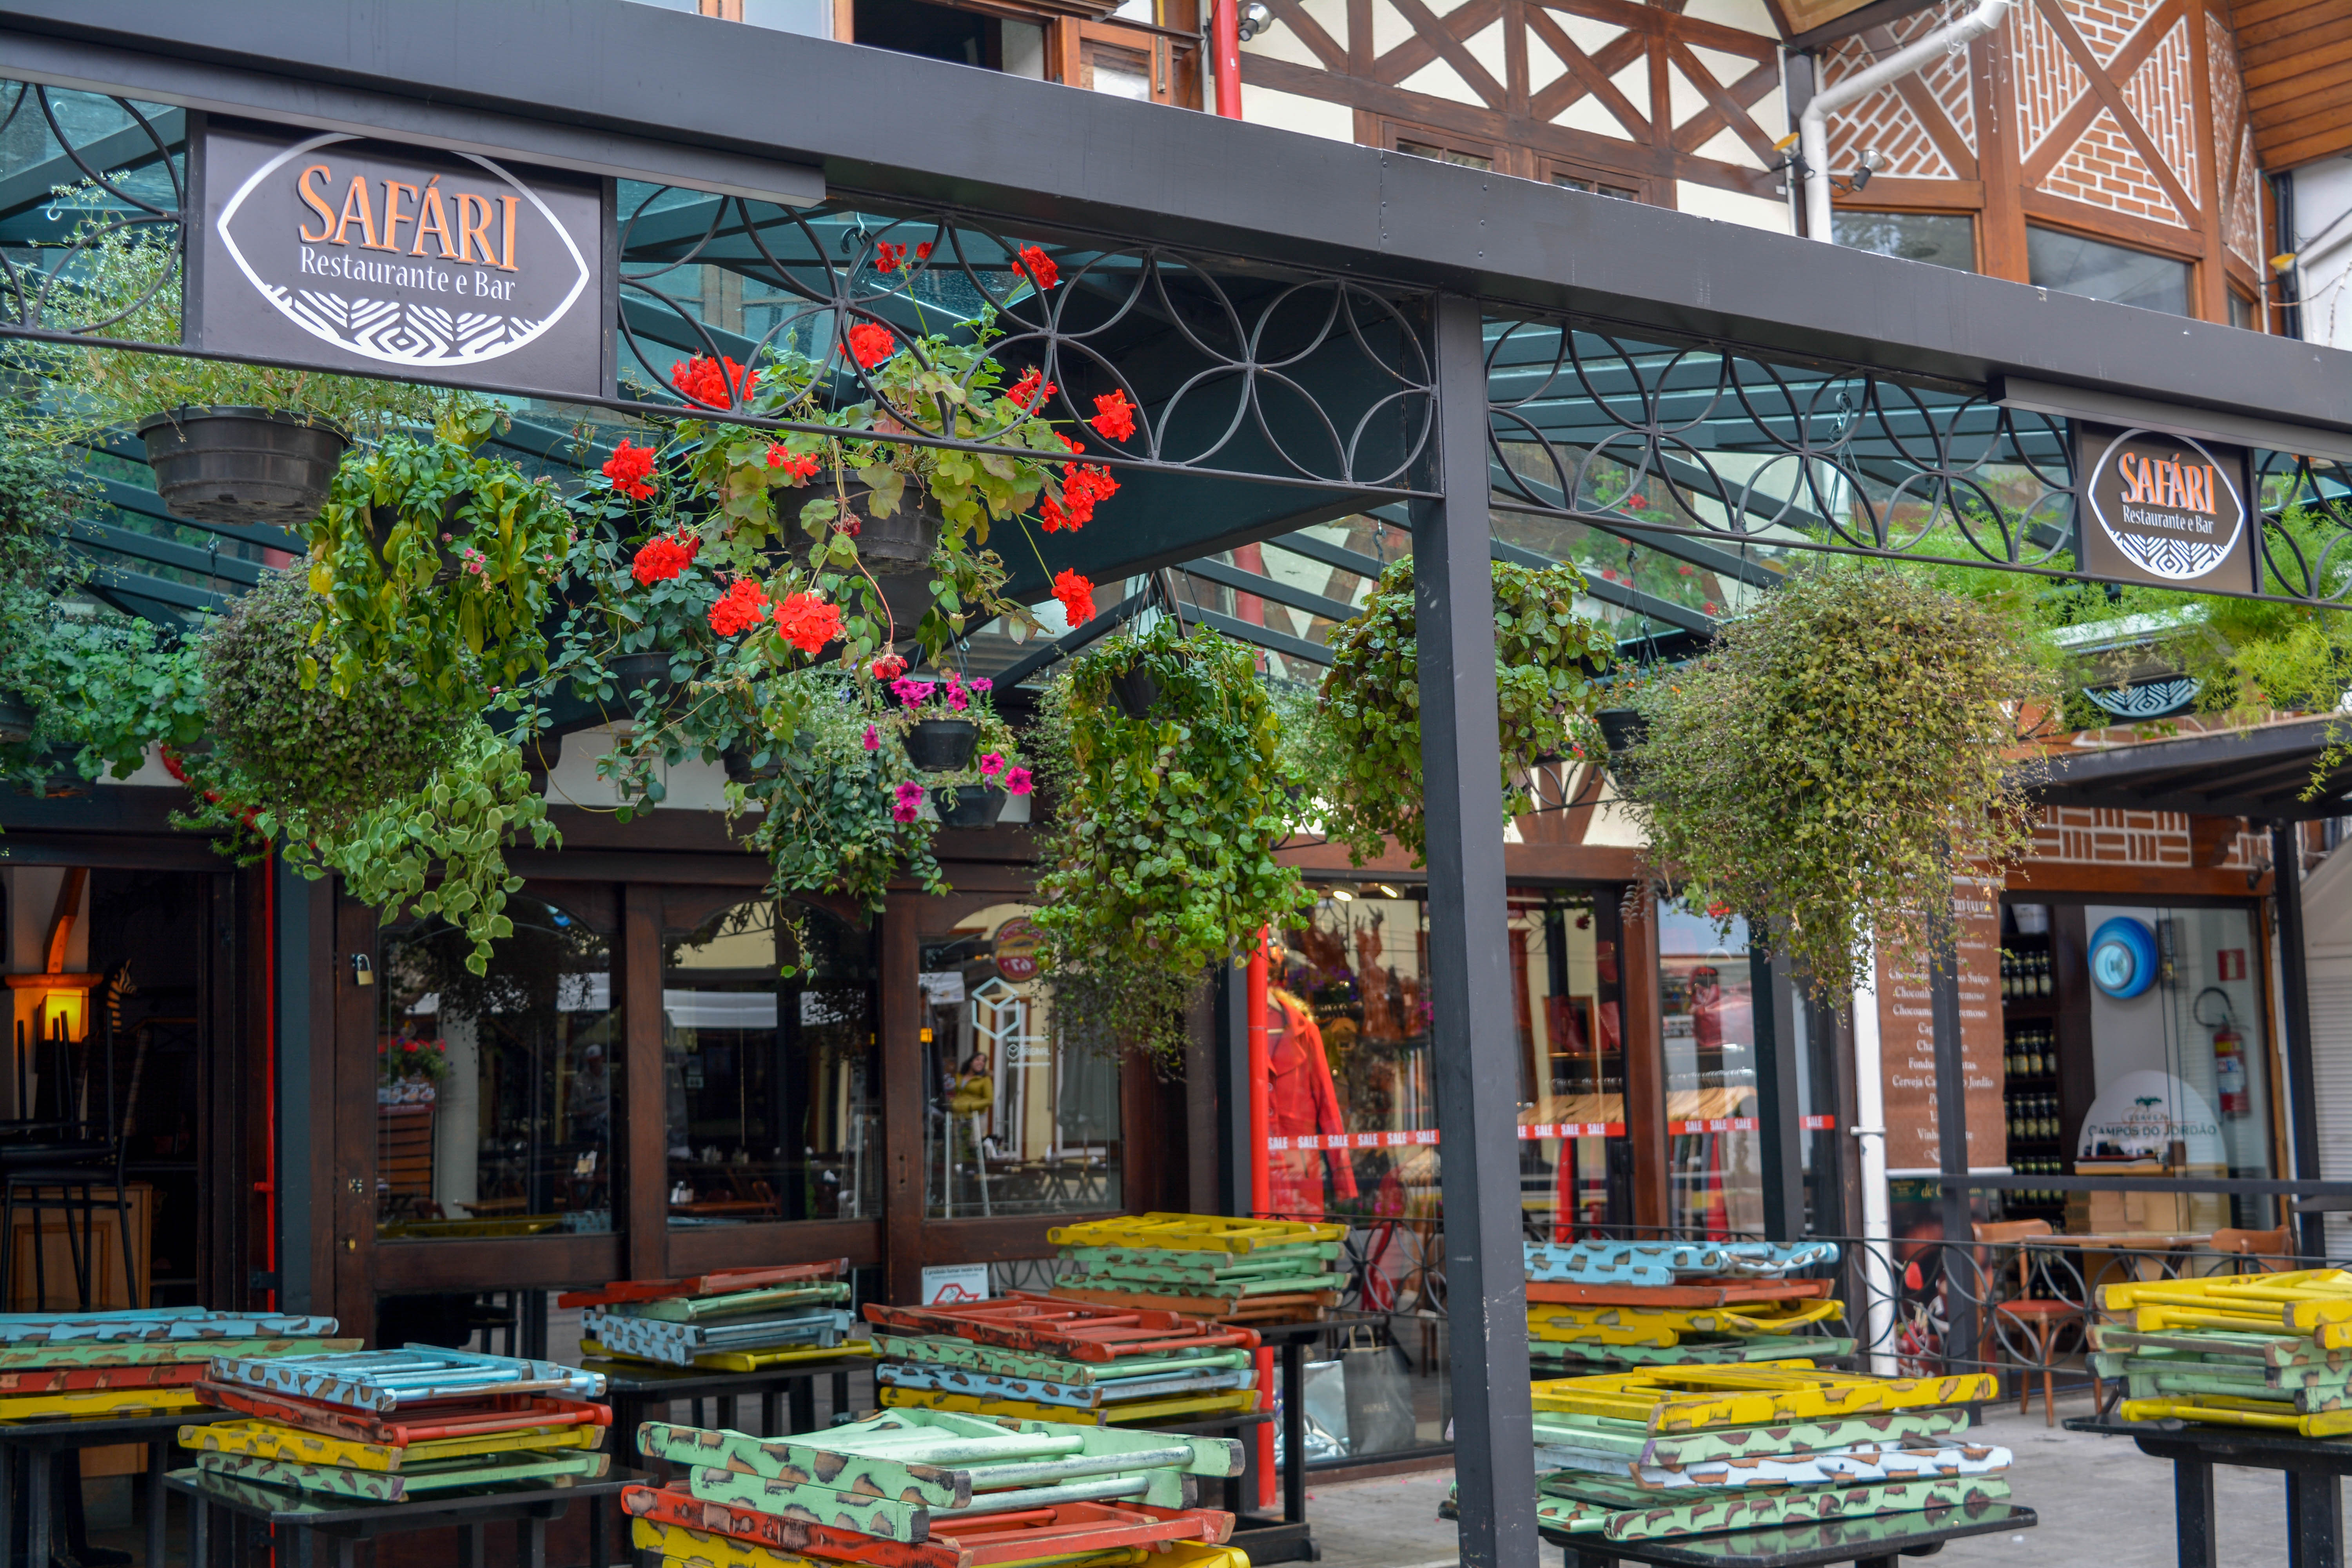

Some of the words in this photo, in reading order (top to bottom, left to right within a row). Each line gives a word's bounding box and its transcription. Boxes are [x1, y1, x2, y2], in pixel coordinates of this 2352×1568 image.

[298, 165, 520, 272] SAFÁRI
[300, 246, 449, 292] Restaurante
[456, 274, 467, 294] e
[474, 271, 516, 301] Bar
[2118, 452, 2217, 514] SAFÁRI
[2123, 505, 2186, 531] Restaurante
[2187, 518, 2194, 532] e
[2195, 515, 2214, 534] Bar
[1895, 985, 1931, 998] Choconh
[1958, 992, 1985, 1001] remoso
[1959, 1009, 1987, 1018] remoso
[1893, 1075, 1923, 1088] Cerveja
[1968, 1076, 1993, 1089] Jordão
[1685, 1120, 1702, 1131] SALE
[1710, 1119, 1727, 1130] SALE
[1735, 1118, 1751, 1129] SALE
[1806, 1116, 1822, 1127] SALE
[1518, 1125, 1526, 1136] LE
[1535, 1125, 1553, 1136] SALE
[1561, 1123, 1579, 1135] SALE
[1588, 1123, 1605, 1134] SALE
[2143, 1126, 2160, 1136] DO
[1268, 1136, 1288, 1149] SALE
[1298, 1136, 1319, 1148] SALE
[1328, 1134, 1348, 1147] SALE
[1358, 1133, 1378, 1146] SALE
[1387, 1132, 1407, 1144] SALE
[1416, 1131, 1436, 1143] SALE
